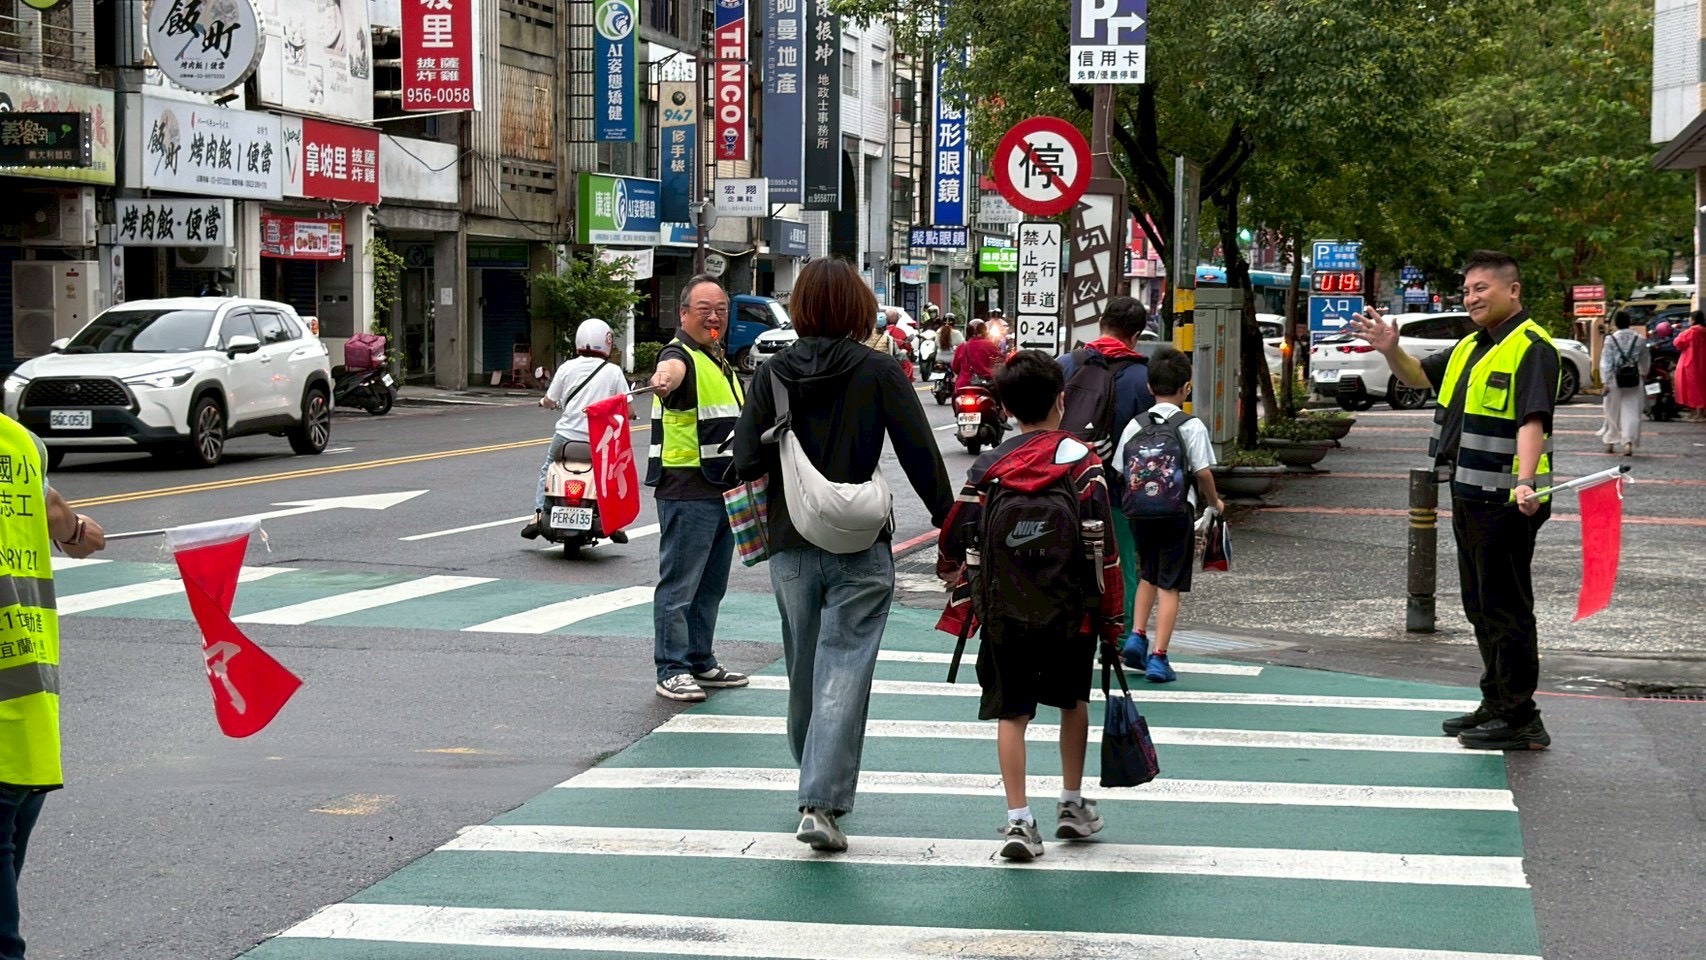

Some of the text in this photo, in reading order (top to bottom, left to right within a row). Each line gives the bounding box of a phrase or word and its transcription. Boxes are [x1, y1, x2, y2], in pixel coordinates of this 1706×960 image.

[1080, 0, 1118, 38] P
[1077, 50, 1140, 67] 信用卡
[720, 27, 742, 124] TENCO
[1077, 70, 1139, 80] 免費/優惠停車
[406, 87, 471, 103] 956-0058
[663, 109, 694, 122] 947
[817, 73, 830, 149] 地政士事務所
[305, 141, 348, 180] 拿坡里
[1018, 142, 1064, 189] 停
[911, 229, 966, 247] 聚點眼鏡
[1317, 245, 1330, 260] P
[1021, 229, 1040, 308] 禁止停車
[1320, 298, 1350, 313] 入口
[551, 511, 591, 525] PER-6135
[1012, 521, 1047, 536] NIKE
[1014, 548, 1046, 557] AIR
